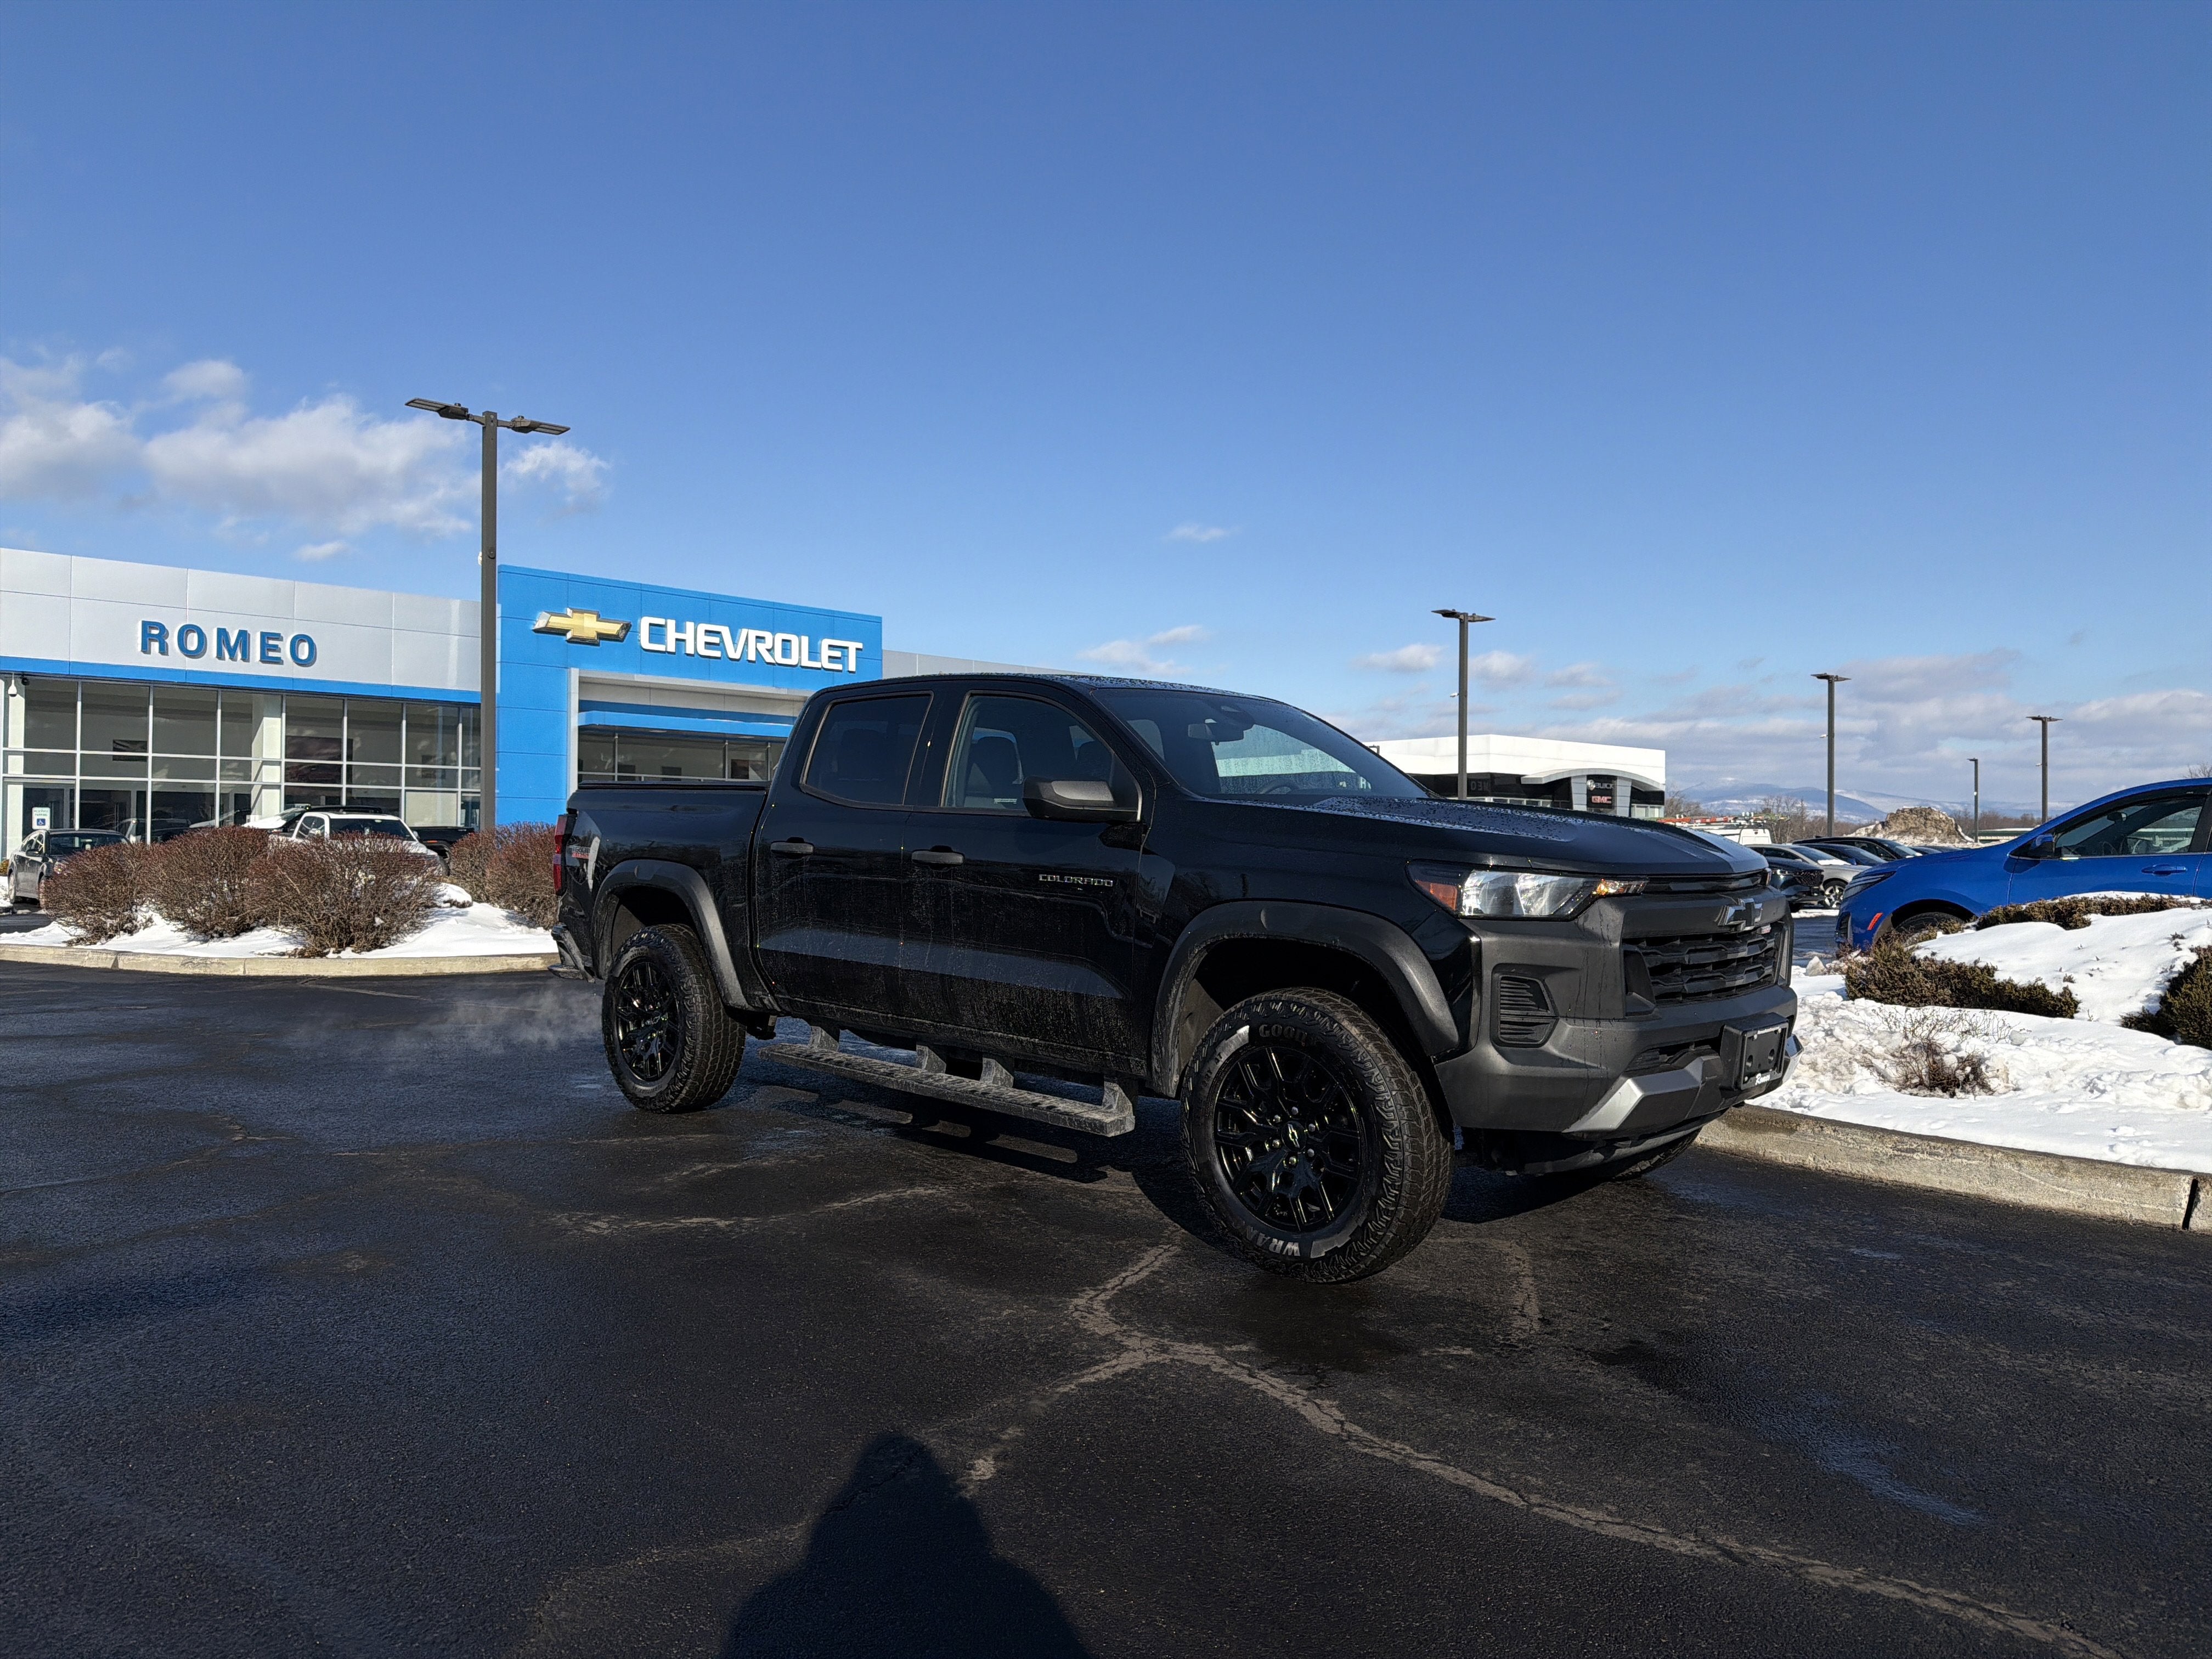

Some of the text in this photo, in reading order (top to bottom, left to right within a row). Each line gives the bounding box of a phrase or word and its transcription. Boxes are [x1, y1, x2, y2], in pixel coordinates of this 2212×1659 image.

[140, 620, 317, 667] ROMEO
[640, 616, 863, 673] CHEVROLET
[1592, 795, 1612, 804] GMC
[1039, 874, 1113, 887] COLORADO
